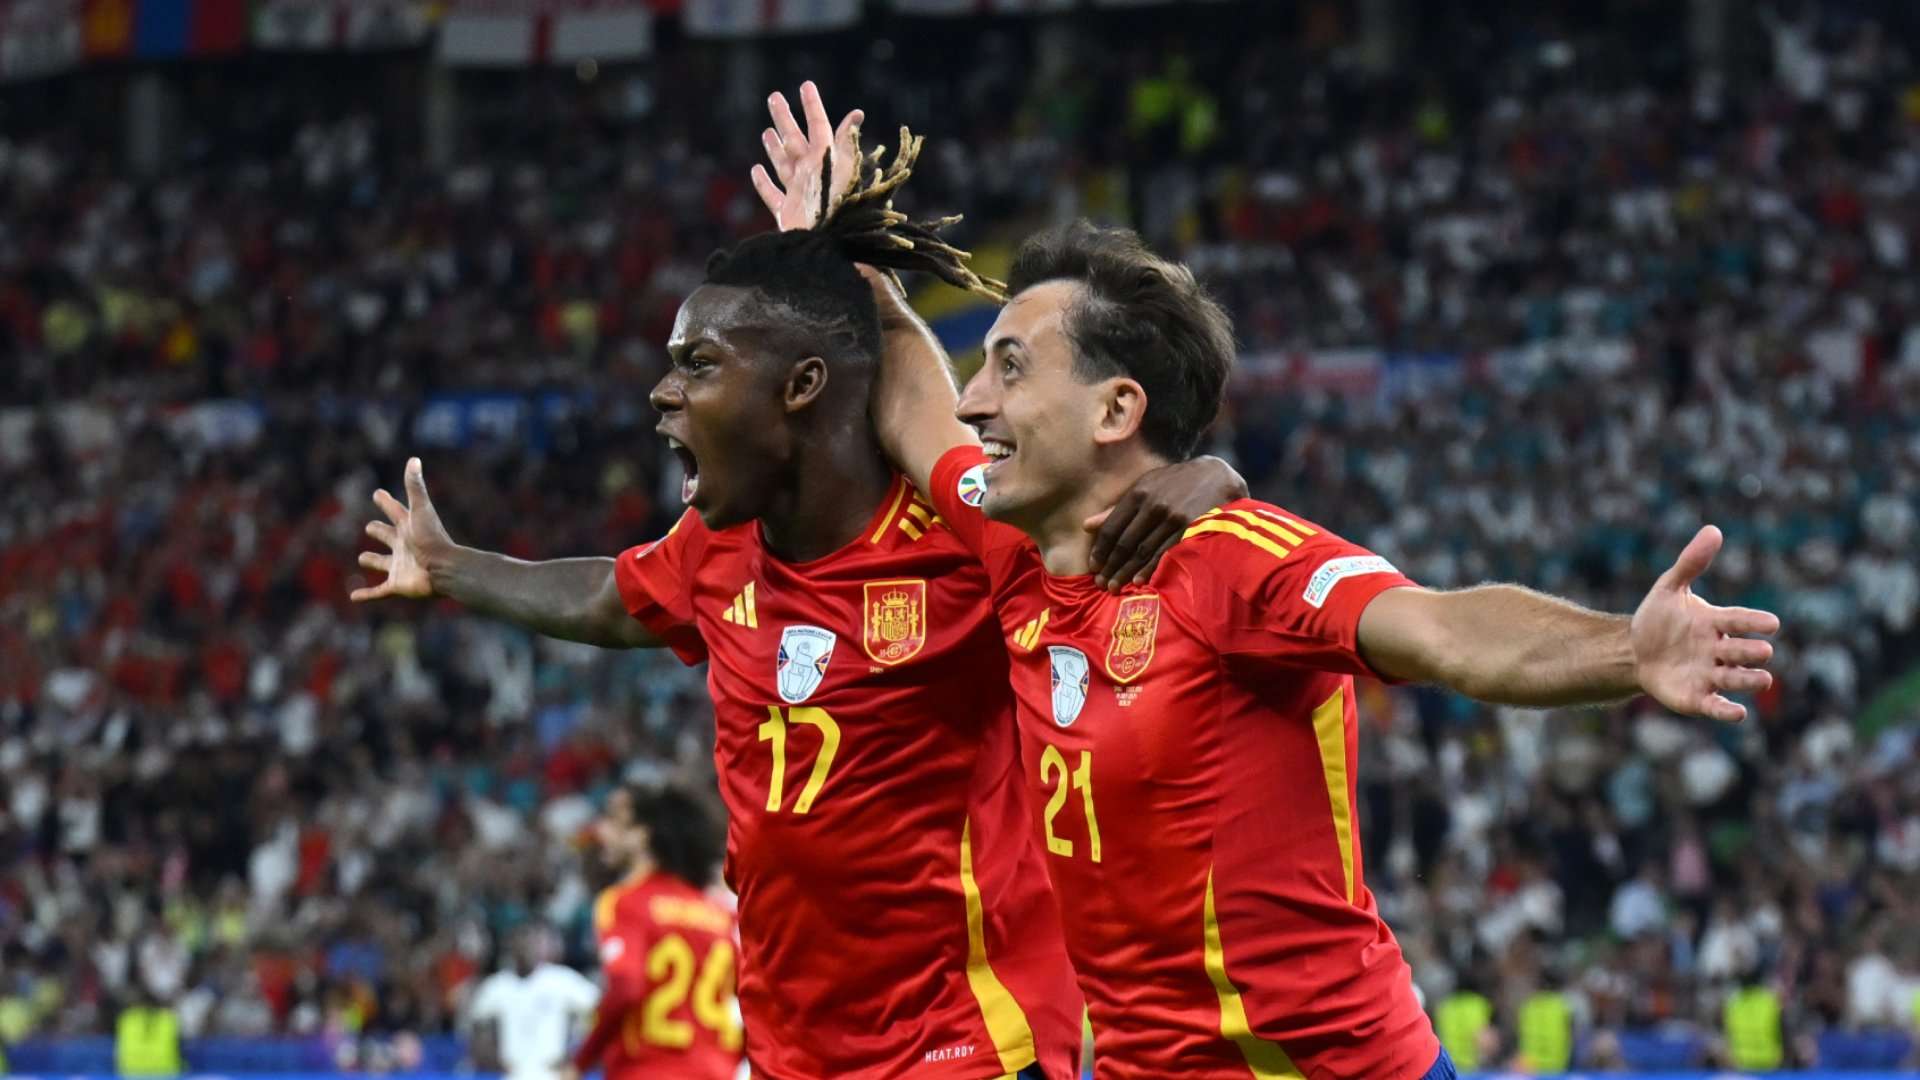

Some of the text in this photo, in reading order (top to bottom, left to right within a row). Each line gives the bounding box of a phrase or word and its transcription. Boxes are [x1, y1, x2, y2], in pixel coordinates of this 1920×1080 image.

[759, 705, 841, 814] 17
[1040, 744, 1102, 863] 21
[643, 933, 743, 1050] 24
[925, 1045, 975, 1063] HEAT.RDY
